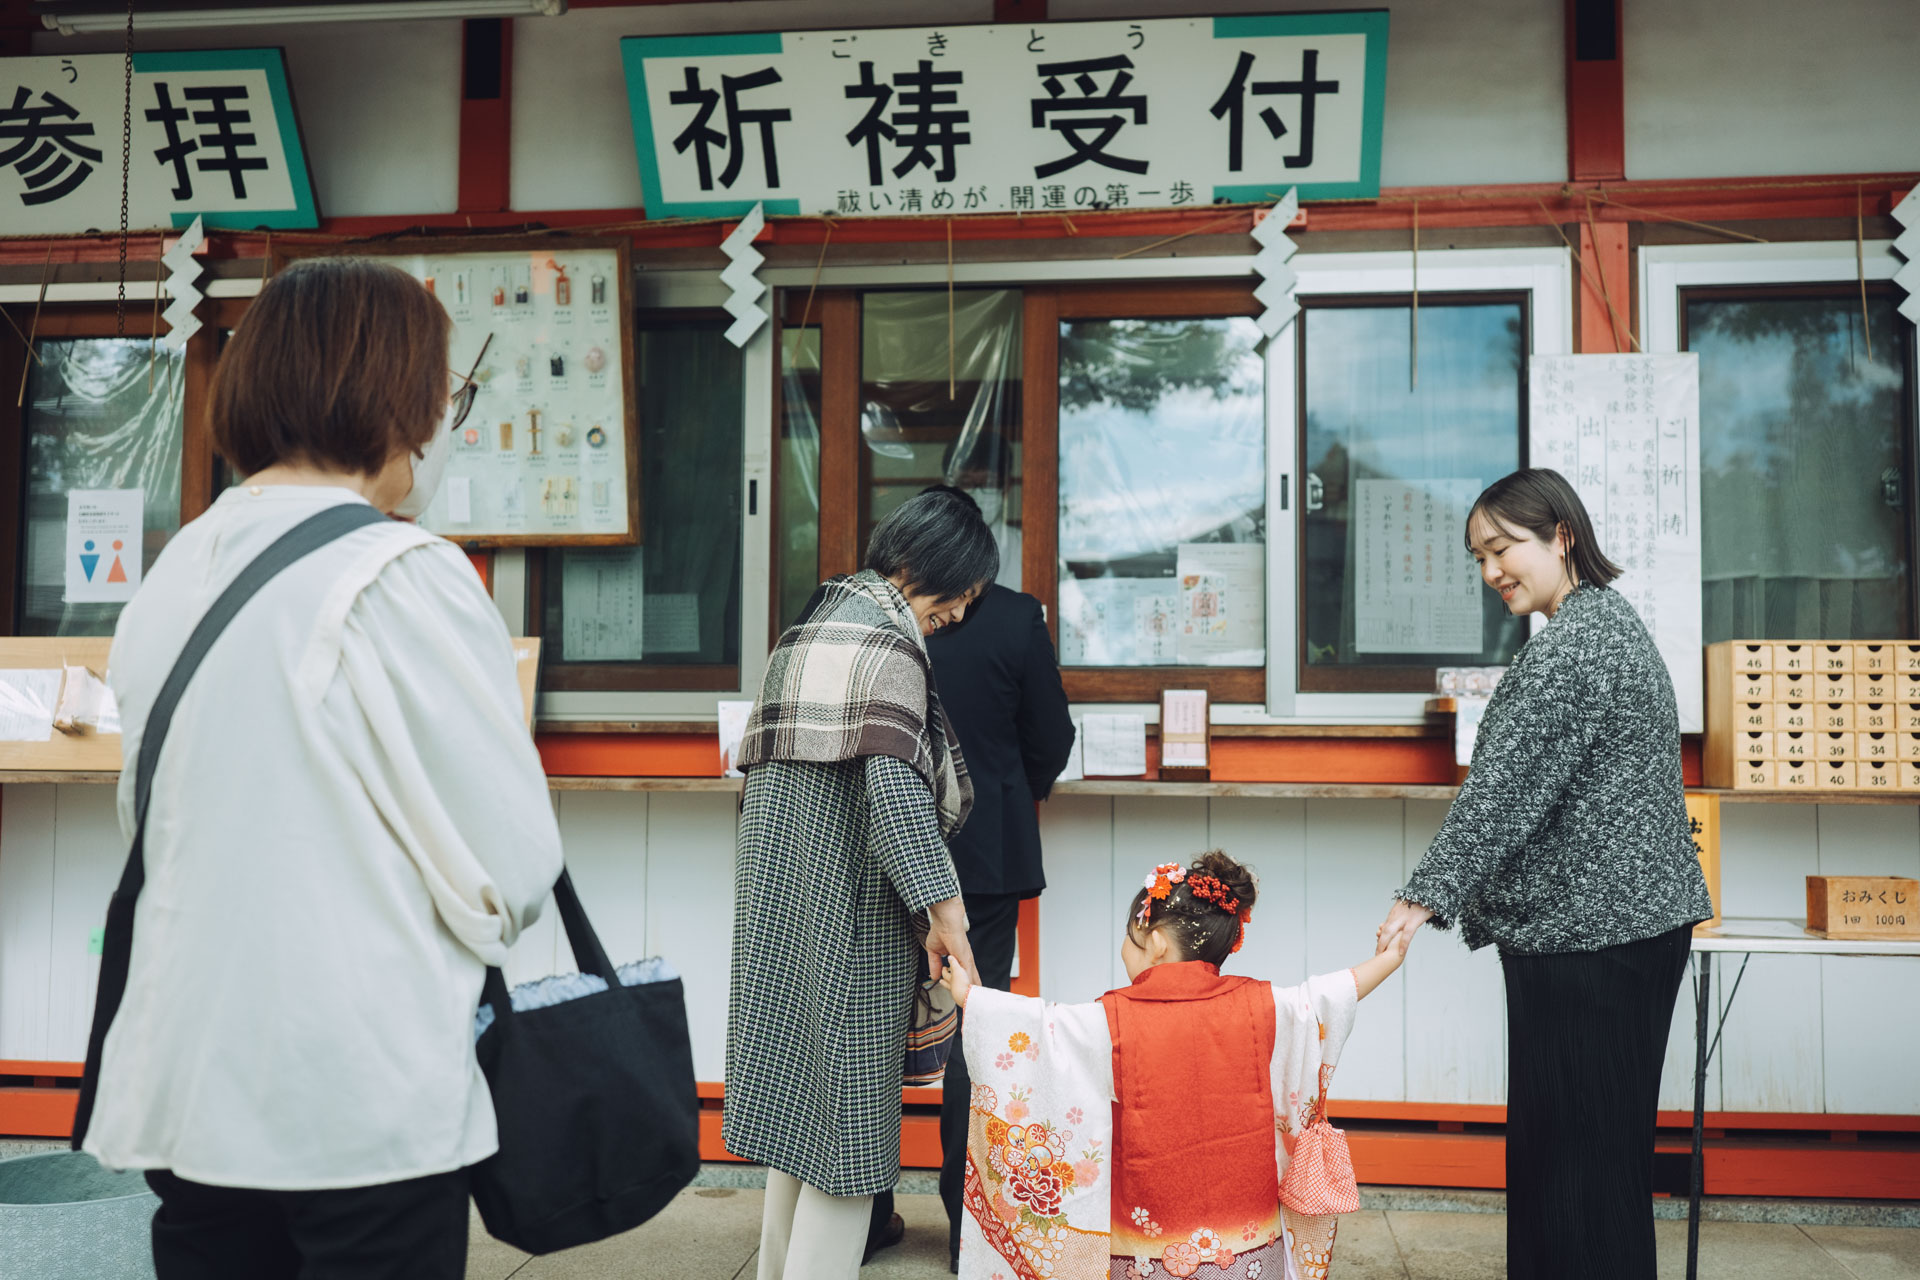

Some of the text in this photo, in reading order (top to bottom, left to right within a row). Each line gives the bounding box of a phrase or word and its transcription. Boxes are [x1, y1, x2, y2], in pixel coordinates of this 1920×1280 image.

[669, 48, 1340, 191] 祈祷受付
[0, 82, 269, 206] 参拝
[1662, 418, 1683, 536] ご祈祷
[1747, 659, 1762, 668] 46
[1788, 659, 1801, 668] 41
[1828, 659, 1844, 669] 36
[1869, 658, 1882, 668] 31
[1747, 687, 1762, 696] 47
[1789, 688, 1803, 697] 42
[1828, 688, 1844, 697] 37
[1869, 687, 1884, 696] 32
[1748, 715, 1763, 725] 48
[1788, 716, 1804, 726] 43
[1828, 716, 1844, 726] 38
[1869, 715, 1884, 726] 33
[1748, 744, 1763, 754] 49
[1789, 746, 1804, 755] 44
[1829, 746, 1845, 756] 39
[1871, 745, 1885, 755] 34
[1750, 773, 1765, 784] 50
[1789, 775, 1805, 784] 45
[1829, 775, 1845, 785] 40
[1871, 775, 1887, 786] 35
[1842, 889, 1906, 905] おみくじ
[1844, 914, 1905, 926] 1回 100円
